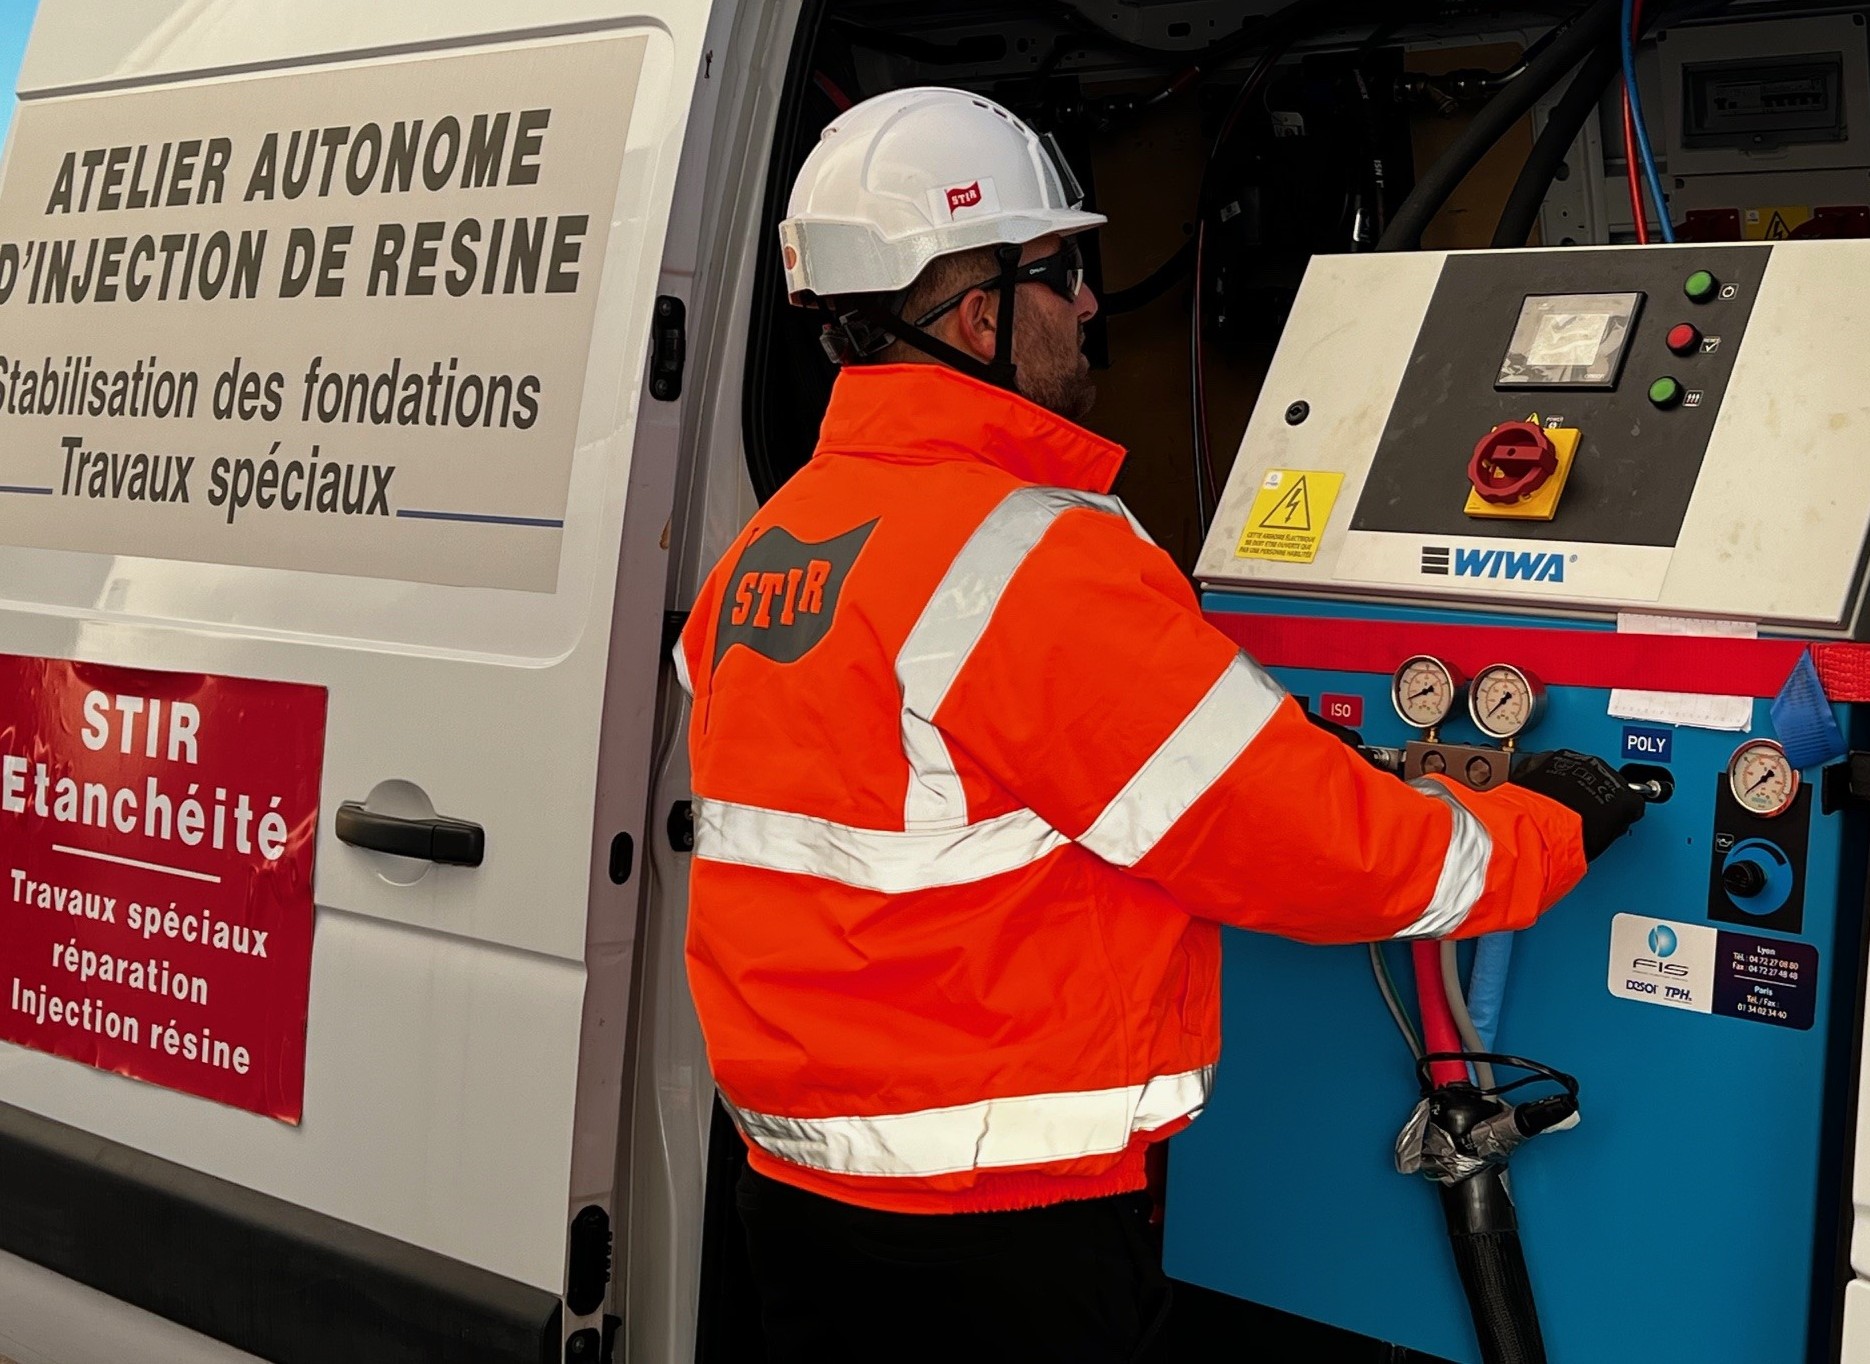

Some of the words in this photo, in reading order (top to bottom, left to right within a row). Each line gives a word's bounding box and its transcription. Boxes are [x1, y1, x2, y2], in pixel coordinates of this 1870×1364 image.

[46, 137, 233, 215] ATELIER
[244, 108, 552, 202] AUTONOME
[951, 190, 977, 205] STIR
[279, 226, 353, 298] DE
[367, 215, 589, 296] RESINE
[213, 356, 284, 420] des
[302, 355, 540, 429] fondations
[61, 436, 195, 503] Travaux
[208, 441, 396, 523] spéciaux
[731, 559, 832, 628] STIR
[81, 690, 200, 764] STIR
[1330, 702, 1351, 718] ISO
[1627, 735, 1667, 753] POLY
[2, 755, 288, 861] Etanchéité
[11, 869, 116, 923] Travaux
[127, 901, 269, 958] spéciaux
[52, 939, 207, 1005] réparation
[1632, 958, 1689, 976] FIS
[1748, 965, 1758, 973] 04
[1759, 966, 1768, 975] 72
[1768, 968, 1778, 976] 27
[1749, 955, 1758, 963] 04
[1759, 957, 1768, 966] 72
[1769, 958, 1779, 967] 27
[1757, 945, 1776, 955] Lyon
[1748, 1005, 1756, 1013] 34
[1757, 1007, 1767, 1016] 02
[1768, 1009, 1777, 1017] 34
[1754, 985, 1773, 996] Paris
[12, 978, 139, 1044] Injection
[150, 1017, 250, 1075] résine
